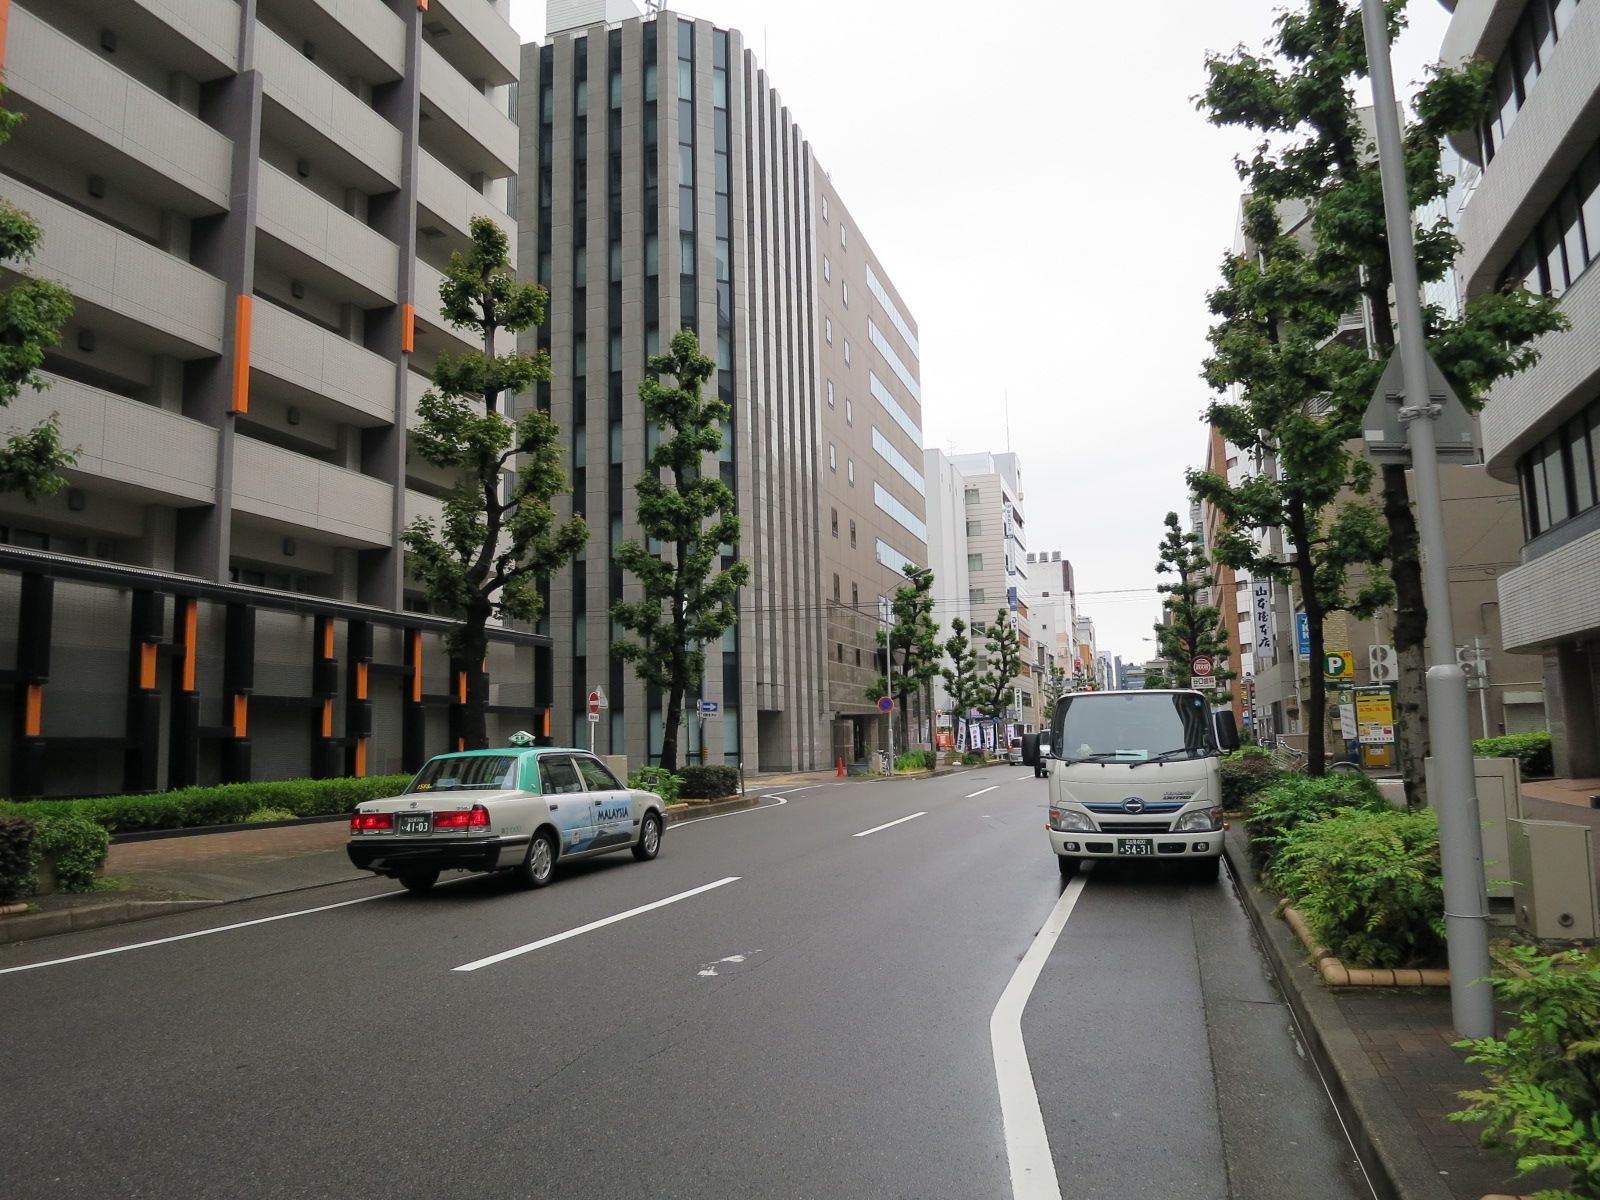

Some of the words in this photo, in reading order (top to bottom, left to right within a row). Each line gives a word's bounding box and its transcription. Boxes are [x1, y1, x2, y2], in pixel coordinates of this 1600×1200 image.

[1328, 656, 1342, 674] P
[598, 806, 629, 821] MALAYSIA
[406, 822, 429, 832] 41-03
[1125, 844, 1151, 855] 54-31
